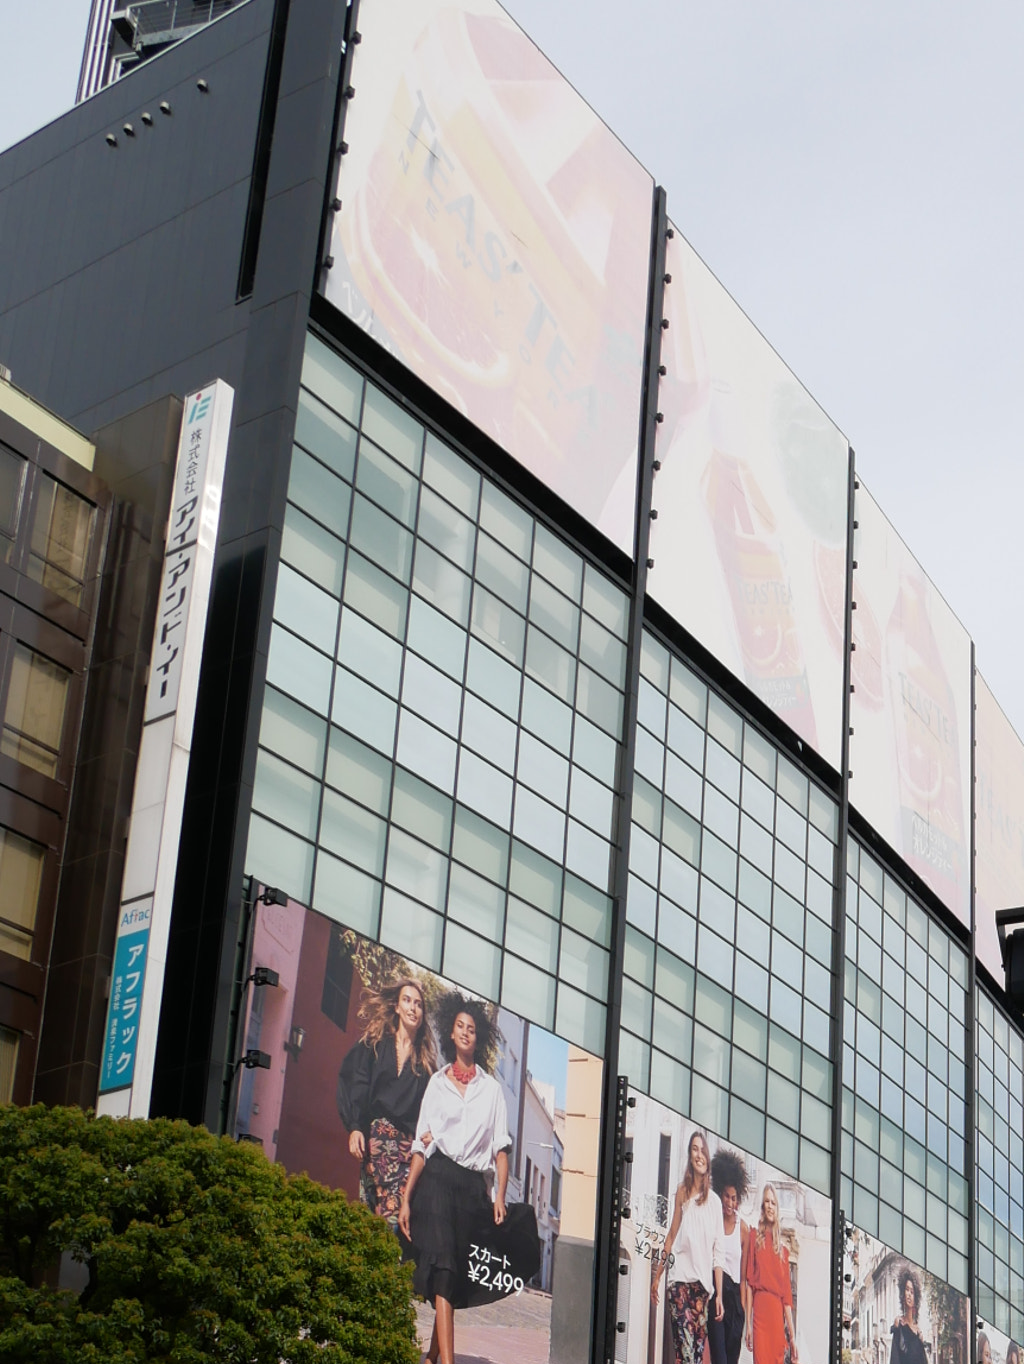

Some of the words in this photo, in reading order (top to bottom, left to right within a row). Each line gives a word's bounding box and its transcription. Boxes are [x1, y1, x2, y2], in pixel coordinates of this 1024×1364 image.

[184, 429, 203, 494] 株式会社
[121, 908, 150, 927] Aflac
[116, 943, 144, 1075] アフラック
[636, 1222, 666, 1245] ブラウス
[468, 1244, 511, 1269] スカート
[467, 1261, 525, 1297] ¥2,499
